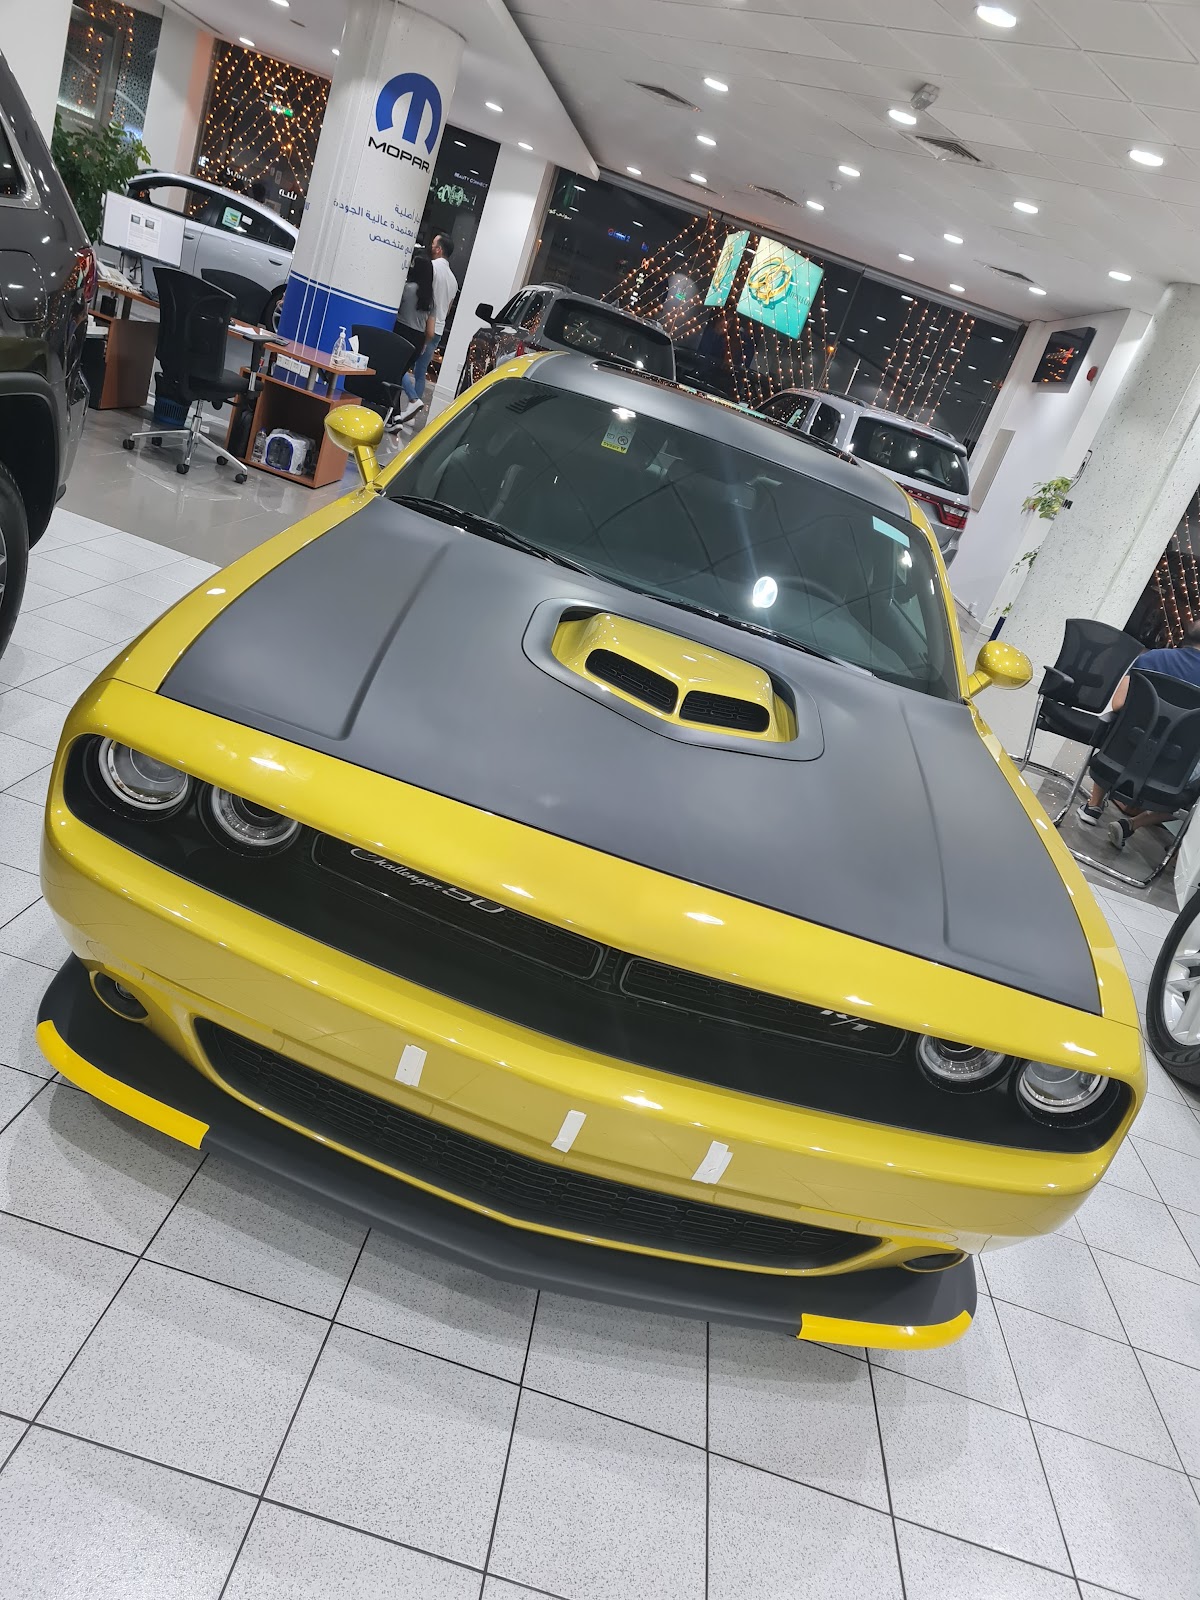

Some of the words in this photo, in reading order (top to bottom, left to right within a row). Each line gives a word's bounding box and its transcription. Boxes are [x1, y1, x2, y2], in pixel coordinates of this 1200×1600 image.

[368, 136, 430, 173] MOPAR
[333, 197, 363, 217] الجودة
[365, 209, 388, 227] عالية
[369, 233, 404, 251] متخصص
[350, 848, 443, 891] Challenger
